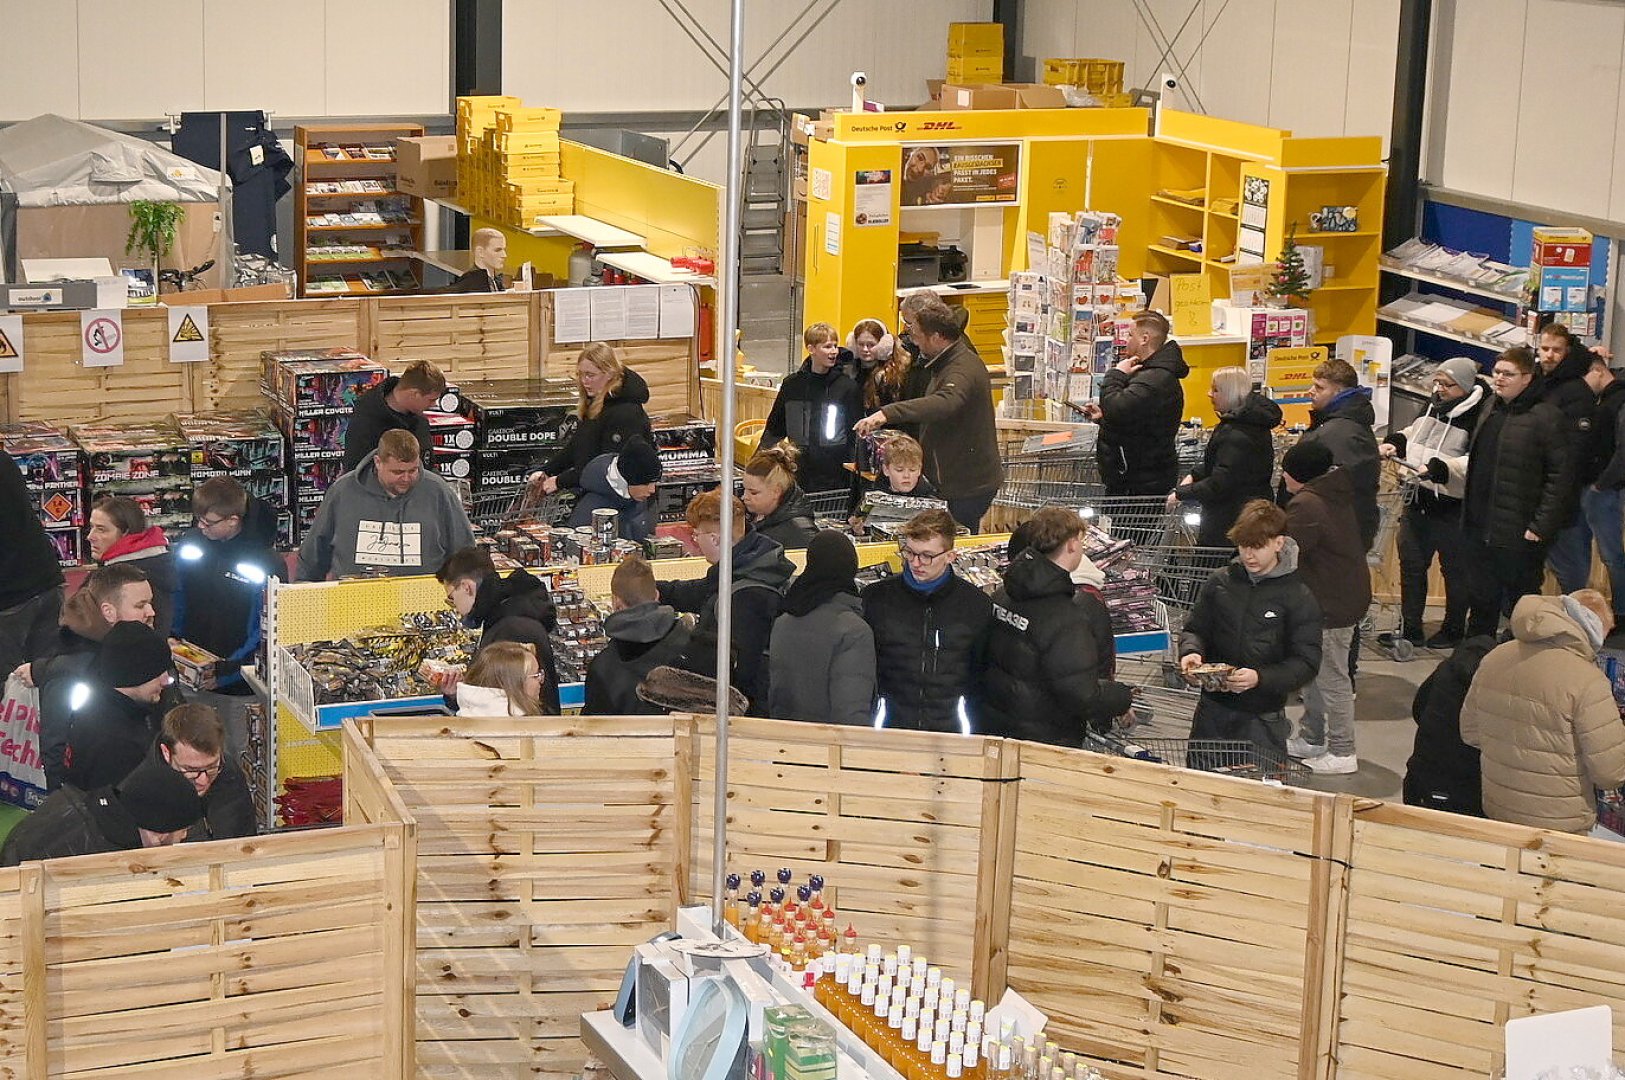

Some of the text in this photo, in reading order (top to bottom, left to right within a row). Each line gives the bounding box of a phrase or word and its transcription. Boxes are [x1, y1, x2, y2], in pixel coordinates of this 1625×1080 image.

[851, 121, 959, 133] Deutsche Post DHL
[1282, 372, 1309, 380] DHL
[299, 406, 354, 418] KILLER COYOTE
[443, 434, 455, 444] 1X
[488, 431, 556, 443] DOUBLE DOPE
[294, 450, 346, 459] KILLER COYOT
[440, 462, 452, 473] 1X
[482, 476, 521, 485] DOUBLE
